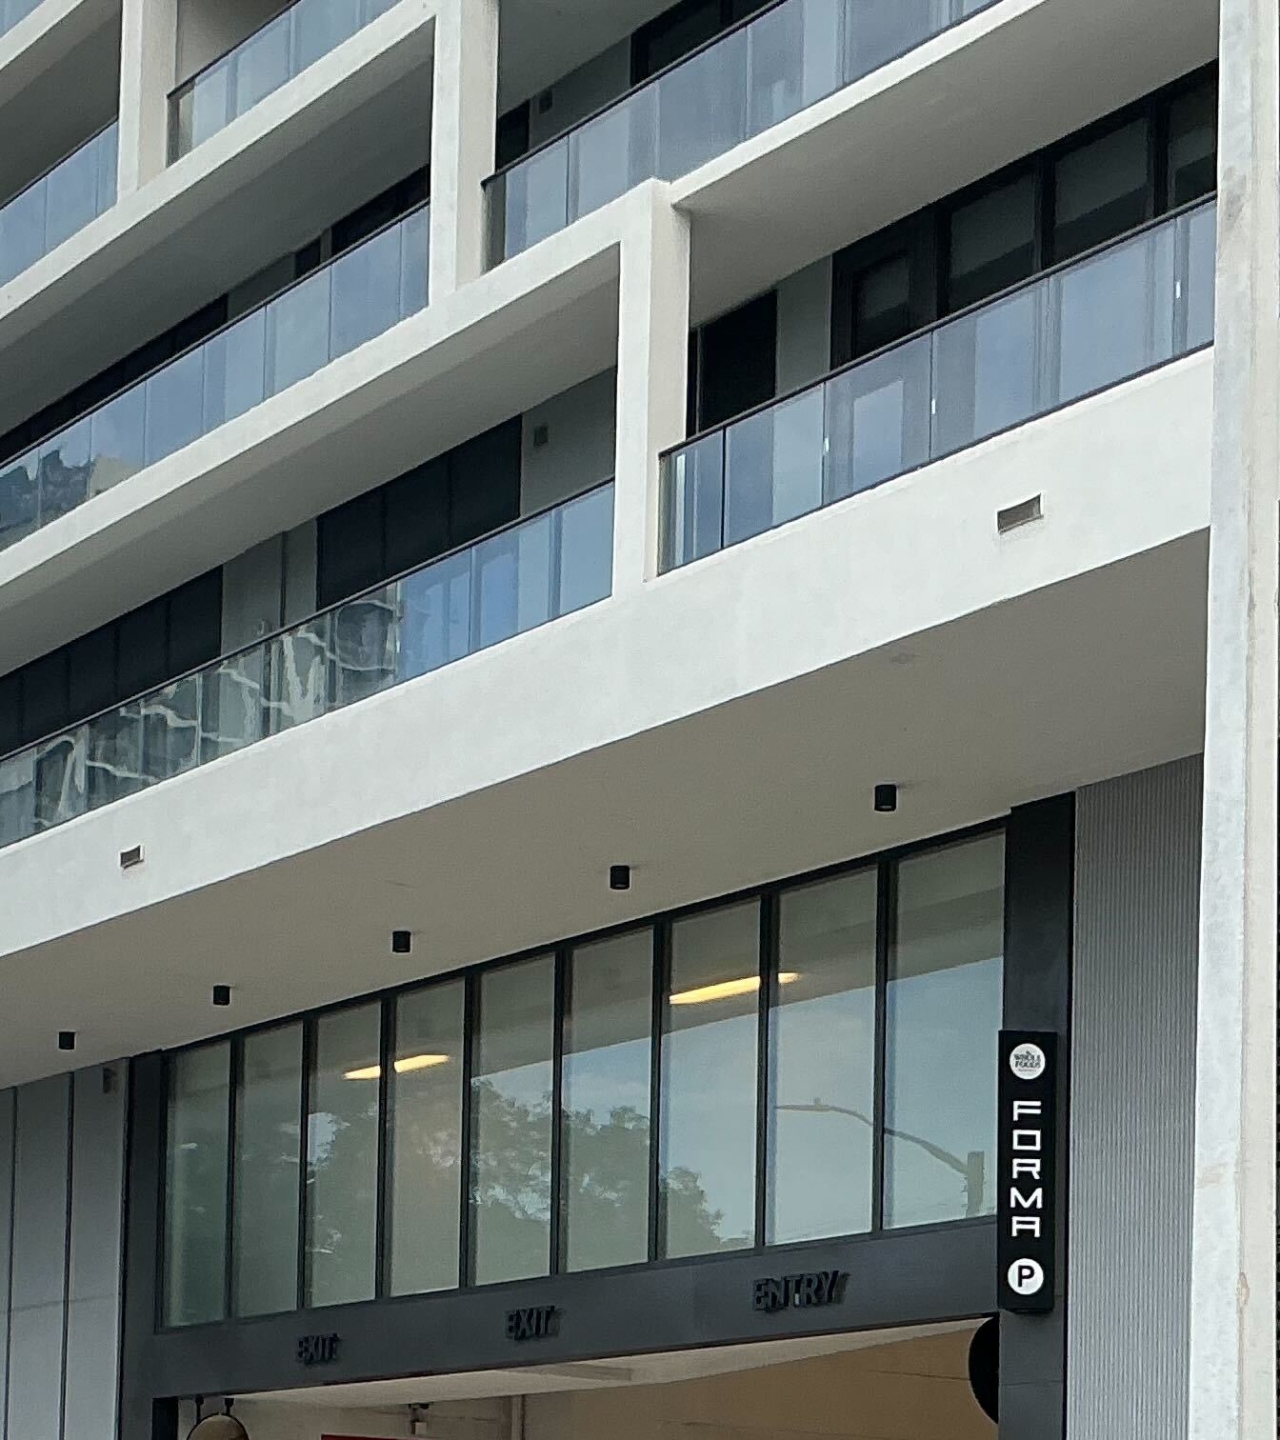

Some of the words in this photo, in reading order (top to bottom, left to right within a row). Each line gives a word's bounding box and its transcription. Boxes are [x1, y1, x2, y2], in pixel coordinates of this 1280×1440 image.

[1010, 1101, 1042, 1238] FORMA
[754, 1270, 843, 1312] ENTRY
[1018, 1265, 1035, 1287] P
[503, 1305, 559, 1340] EXIT
[297, 1332, 340, 1364] EXIT
